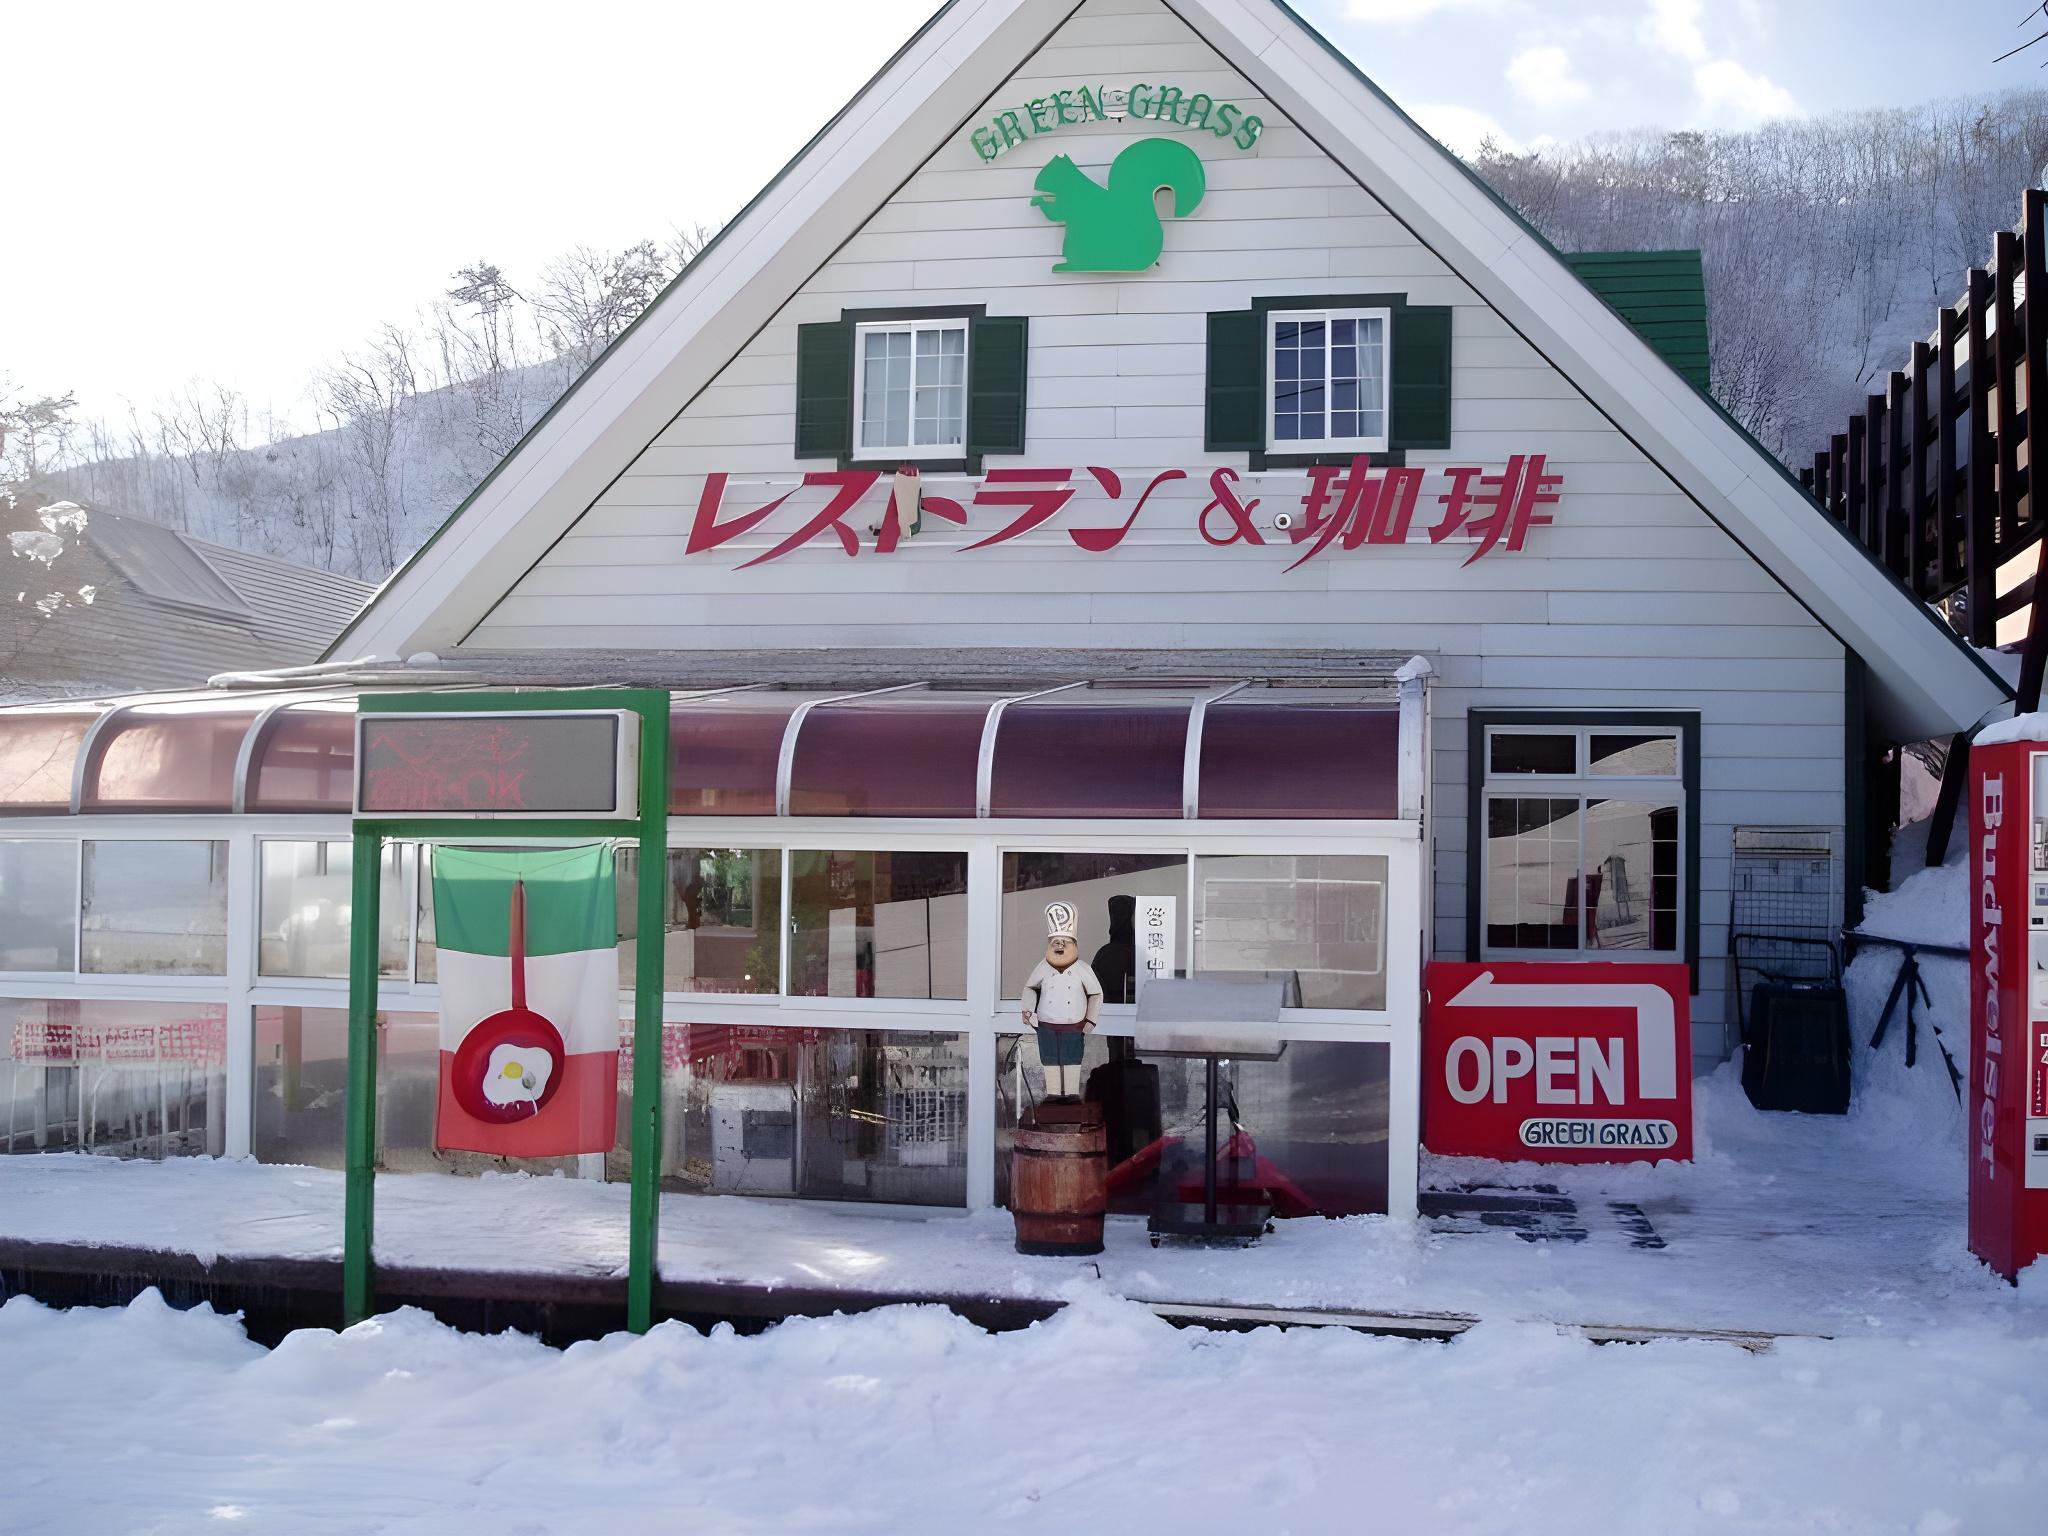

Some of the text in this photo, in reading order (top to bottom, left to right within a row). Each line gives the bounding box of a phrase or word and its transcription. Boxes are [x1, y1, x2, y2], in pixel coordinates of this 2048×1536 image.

[1127, 83, 1264, 150] GRASS
[684, 454, 1563, 574] レストラン & 珈琲
[1980, 771, 2004, 1181] Budweiser
[1445, 1035, 1625, 1105] OPEN
[1525, 1122, 1670, 1145] GREEN GRASS
